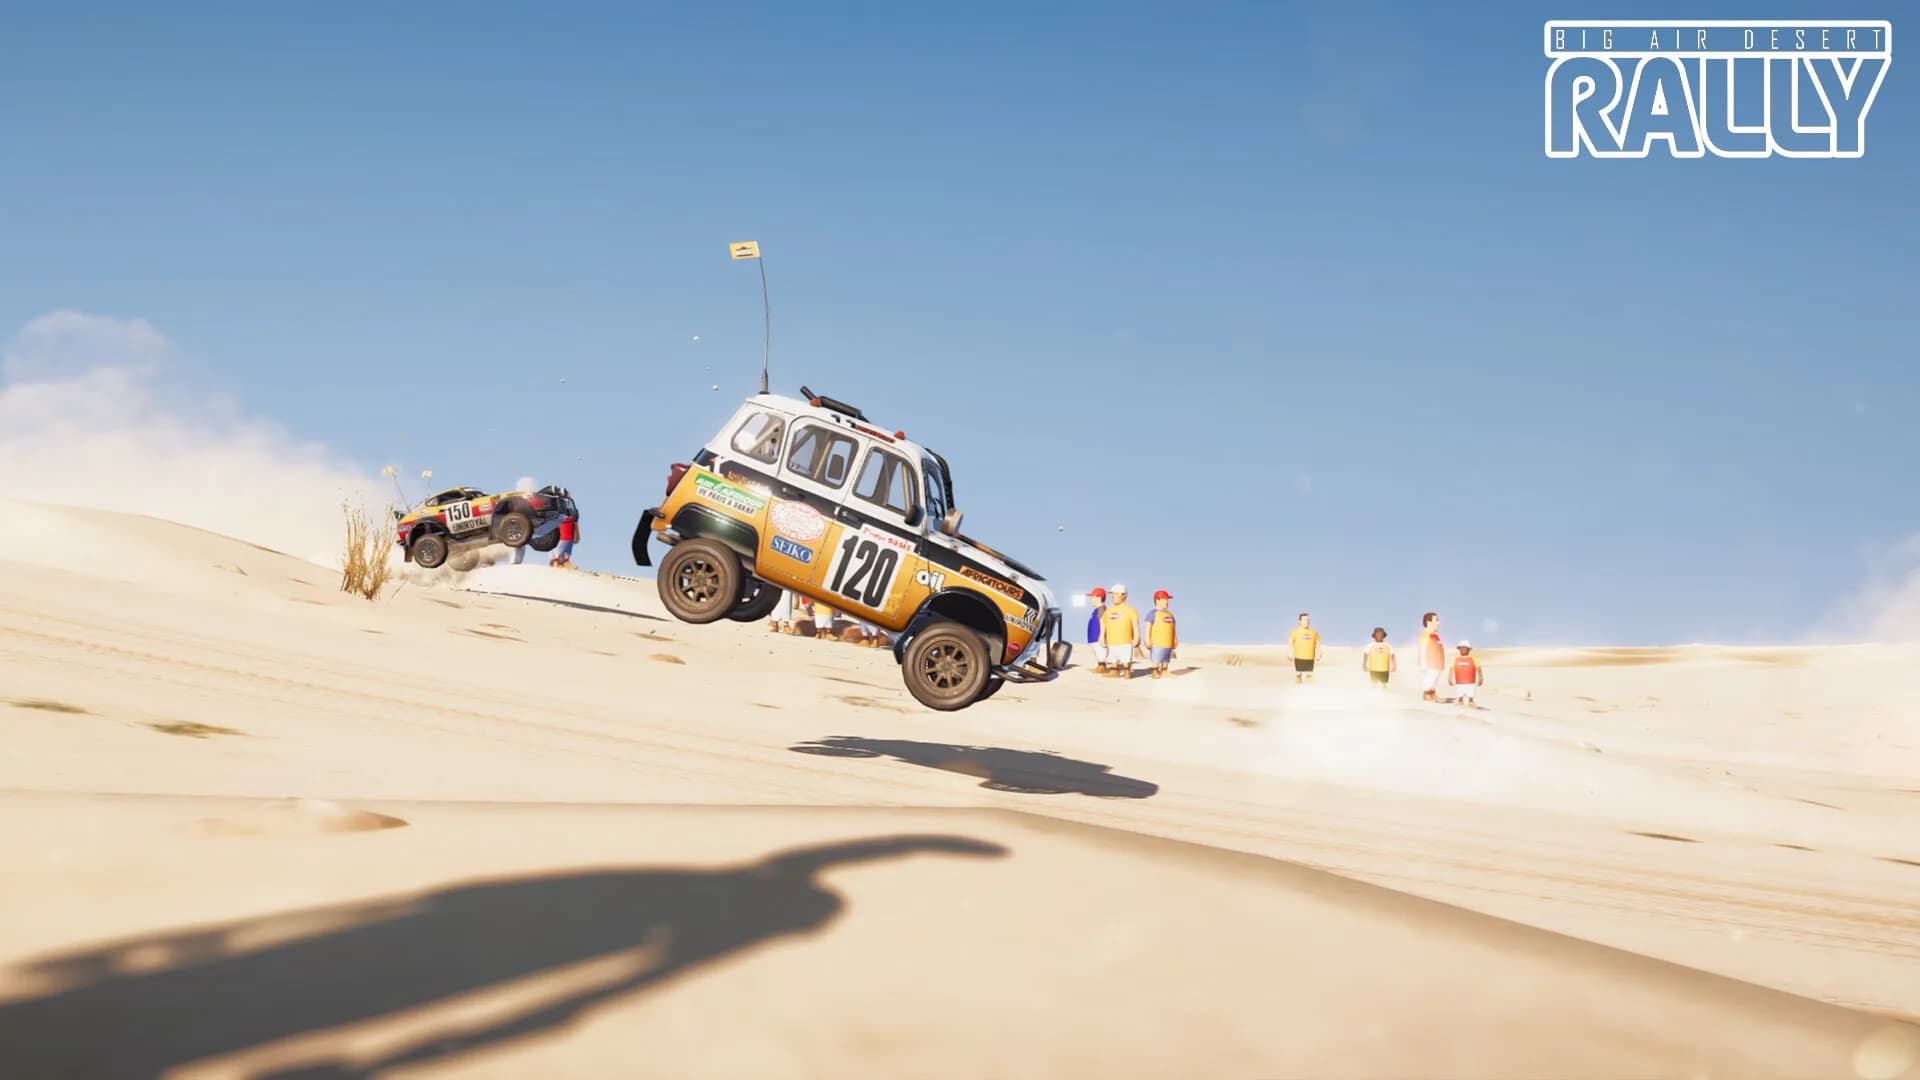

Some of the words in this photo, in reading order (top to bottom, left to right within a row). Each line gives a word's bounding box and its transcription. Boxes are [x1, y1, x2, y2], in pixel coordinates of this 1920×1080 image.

[448, 502, 470, 521] 150
[771, 537, 813, 562] SEIKO
[830, 535, 898, 608] 120
[961, 568, 1022, 599] AFRICATOURS
